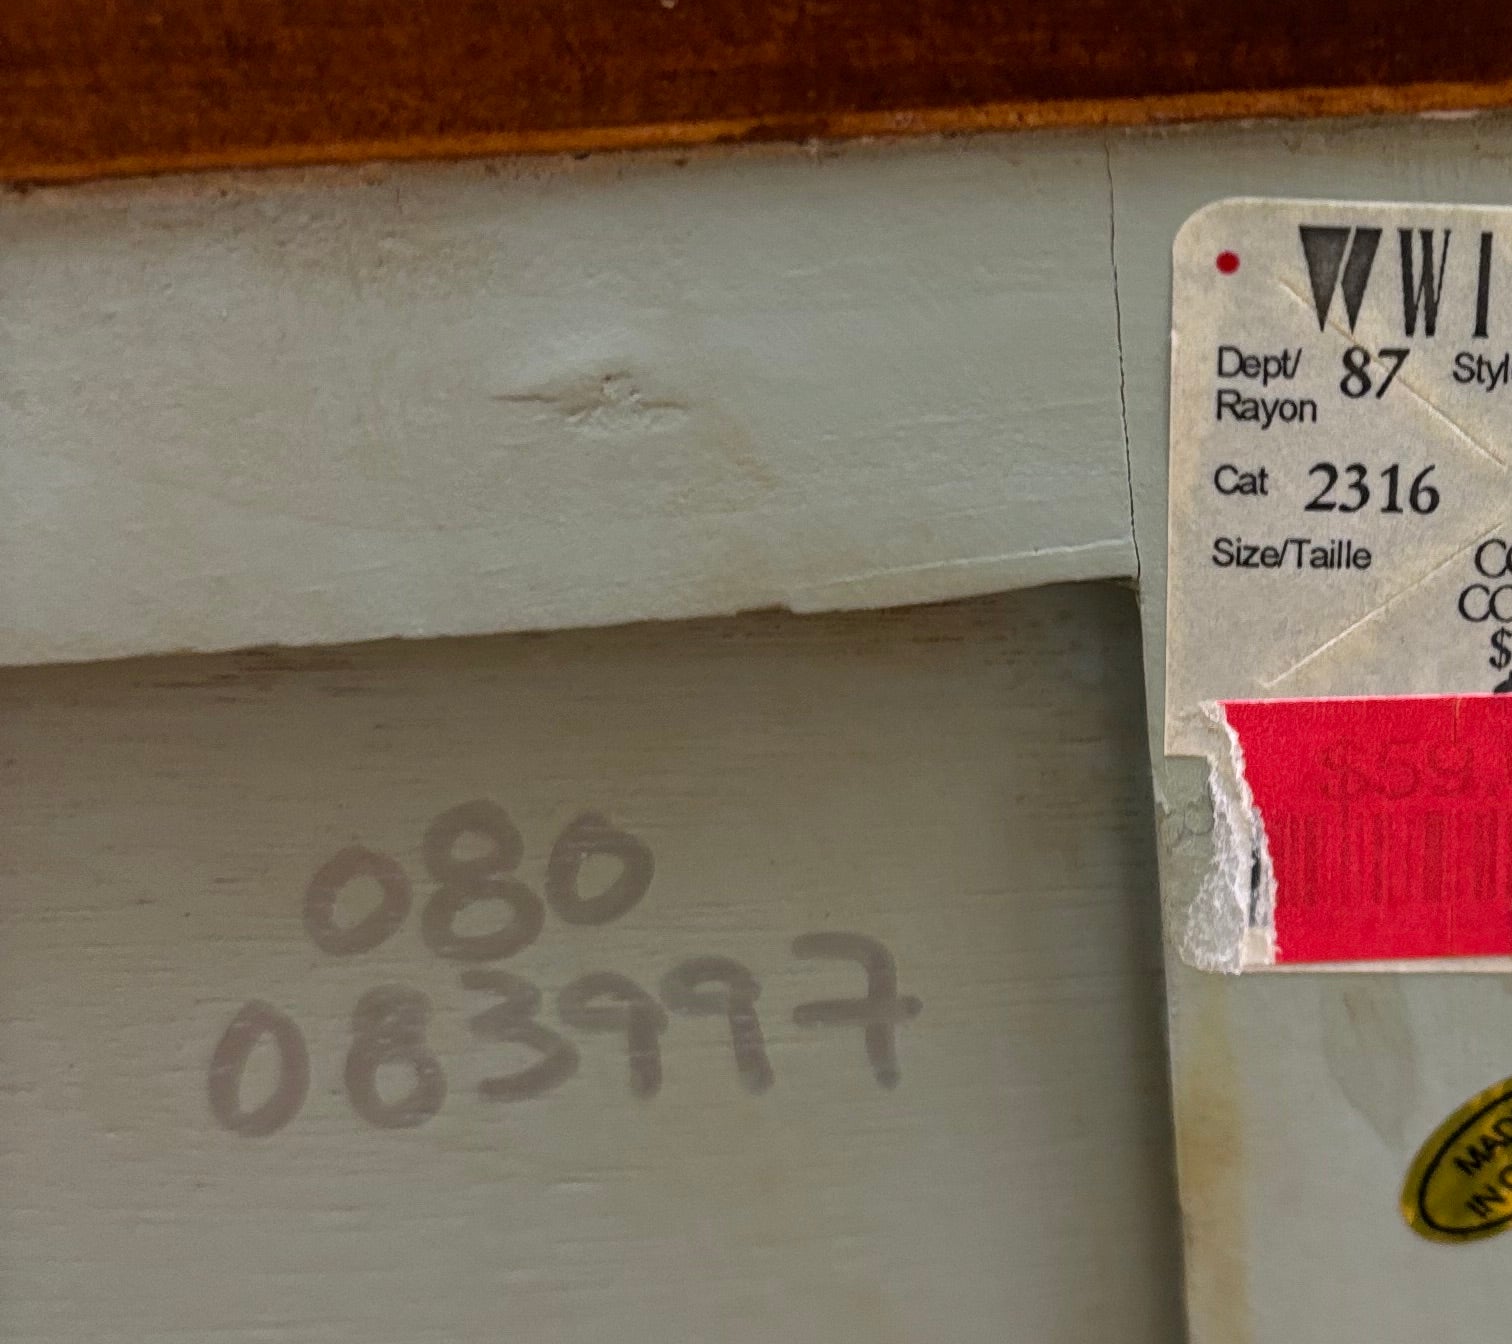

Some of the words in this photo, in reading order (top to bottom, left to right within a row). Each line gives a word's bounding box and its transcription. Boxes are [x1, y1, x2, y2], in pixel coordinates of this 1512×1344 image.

[1216, 345, 1303, 387] Dept/
[1339, 345, 1411, 400] 87
[1215, 388, 1318, 430] Rayon
[1213, 463, 1269, 496] Cat
[1303, 461, 1441, 515] 2316
[1211, 536, 1373, 570] Size/Taille
[302, 798, 657, 962] 080
[208, 931, 924, 1138] 083997
[1463, 1183, 1507, 1219] IN
